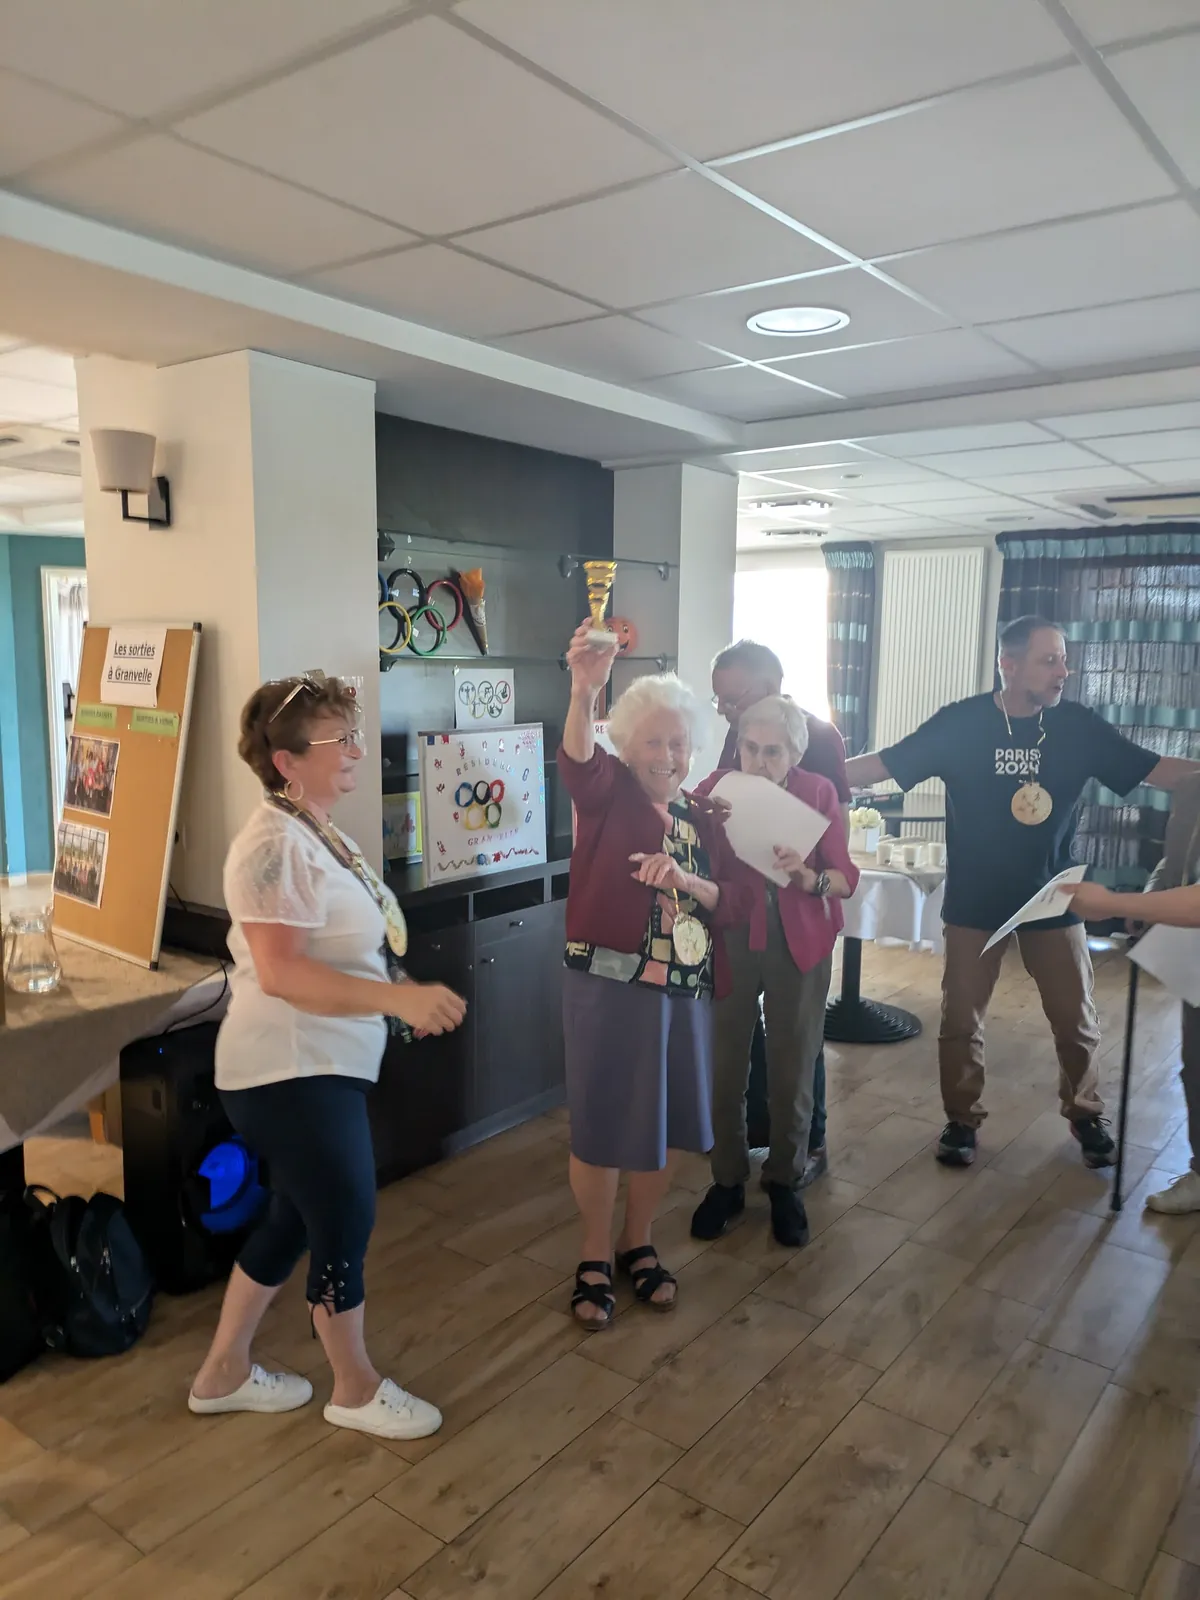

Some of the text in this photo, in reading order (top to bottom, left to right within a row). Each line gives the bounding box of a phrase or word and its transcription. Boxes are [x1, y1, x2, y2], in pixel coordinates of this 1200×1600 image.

[113, 640, 156, 657] Les sorties
[107, 665, 153, 683] à Granvelle
[994, 748, 1040, 761] PARIS
[994, 761, 1040, 775] 2024
